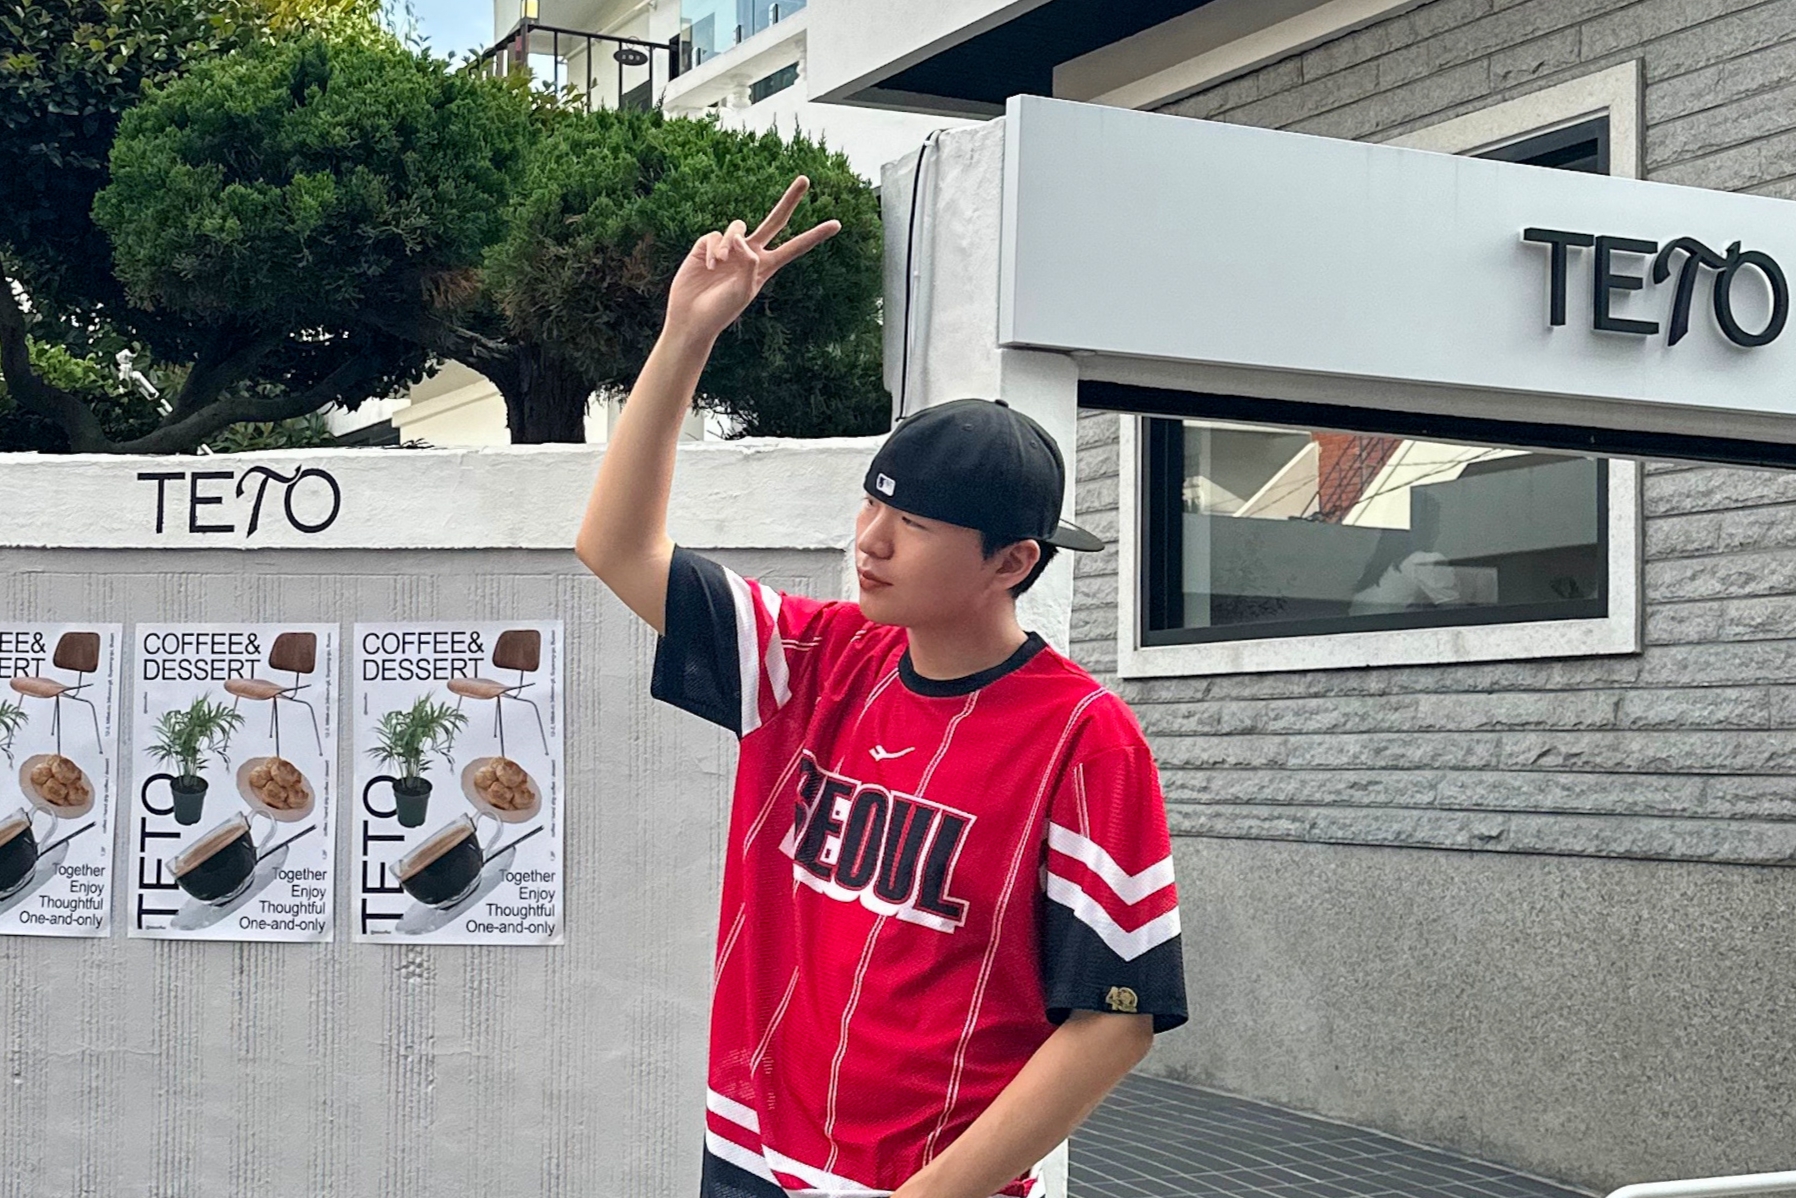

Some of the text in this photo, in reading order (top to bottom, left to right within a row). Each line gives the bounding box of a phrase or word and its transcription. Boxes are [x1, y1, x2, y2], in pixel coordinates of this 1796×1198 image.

[1523, 227, 1789, 347] TETO
[137, 464, 341, 538] TETO
[143, 632, 261, 655] COFFEE&
[362, 631, 484, 655] COFFEE&
[143, 659, 261, 680] DESSERT
[363, 658, 484, 681] DESSERT
[53, 862, 105, 879] Together
[272, 867, 327, 883] Together
[499, 868, 556, 885] Together
[70, 880, 104, 897] Enjoy
[291, 884, 326, 901] Enjoy
[519, 887, 556, 903] Enjoy
[39, 895, 104, 912] Thoughtful
[259, 900, 326, 917] Thoughtful
[486, 903, 556, 920] Thoughtful
[19, 910, 103, 929] One-and-only
[239, 916, 326, 934] One-and-only
[466, 919, 556, 936] One-and-only
